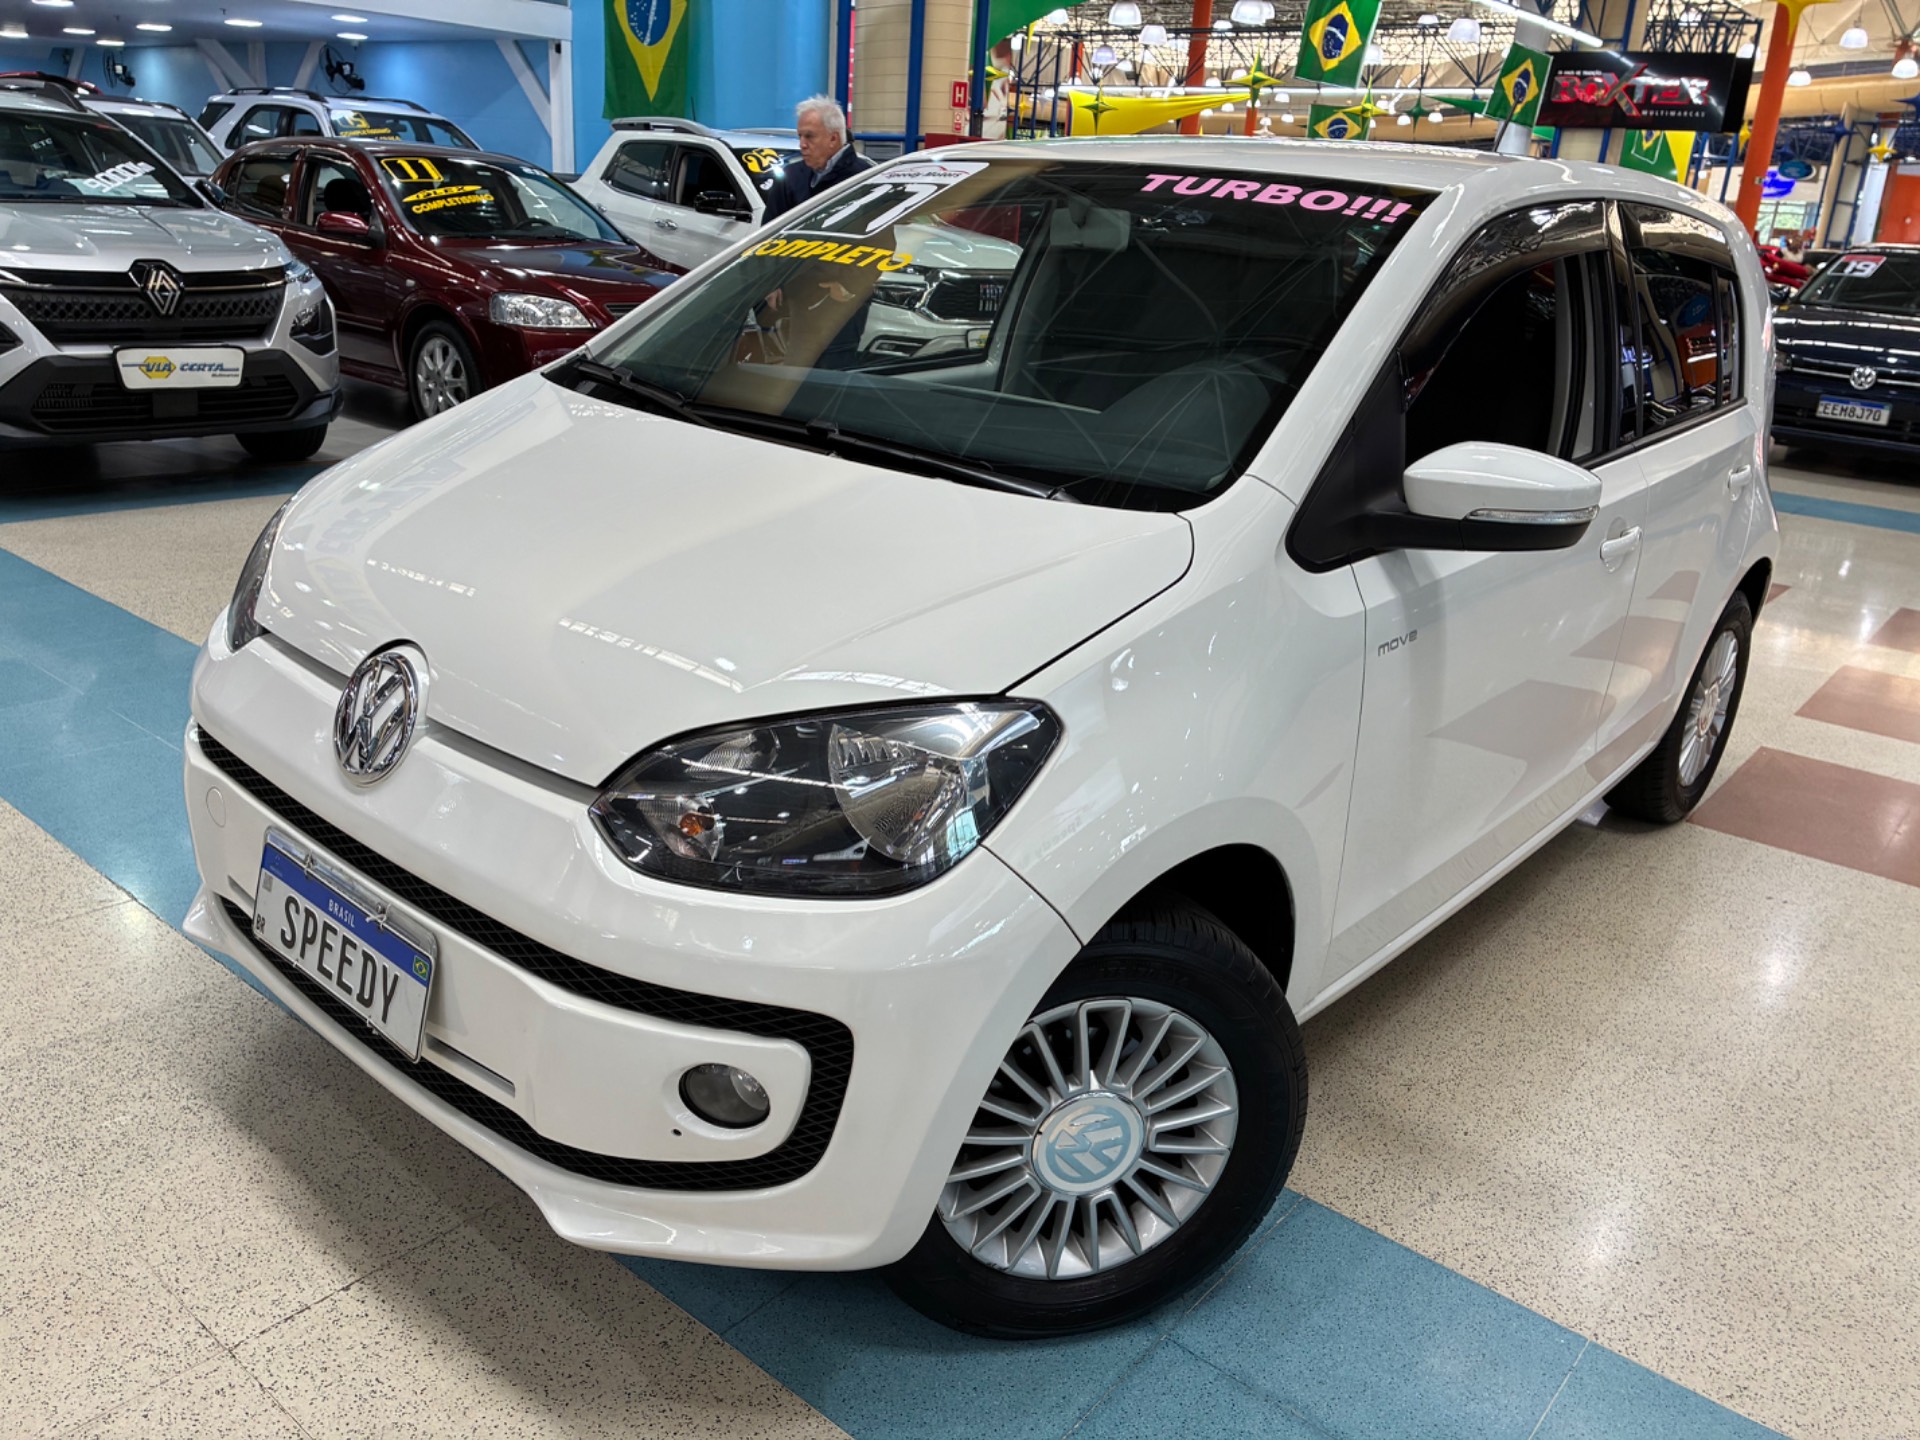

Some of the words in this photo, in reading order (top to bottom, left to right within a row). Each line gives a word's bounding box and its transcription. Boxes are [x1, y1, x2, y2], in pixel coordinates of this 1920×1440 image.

[955, 85, 966, 104] H
[1551, 63, 1710, 117] BOXTER
[1641, 109, 1705, 118] MULTIMARCAS
[396, 158, 441, 180] 11
[821, 183, 939, 233] 17
[1140, 173, 1412, 223] TURBO!!!
[1844, 261, 1878, 275] 19
[145, 362, 172, 372] VIA
[179, 362, 225, 372] CERTA
[1377, 629, 1418, 657] move
[256, 912, 267, 935] BR
[328, 898, 356, 929] BRASIL
[280, 895, 400, 1025] SPEEDY
